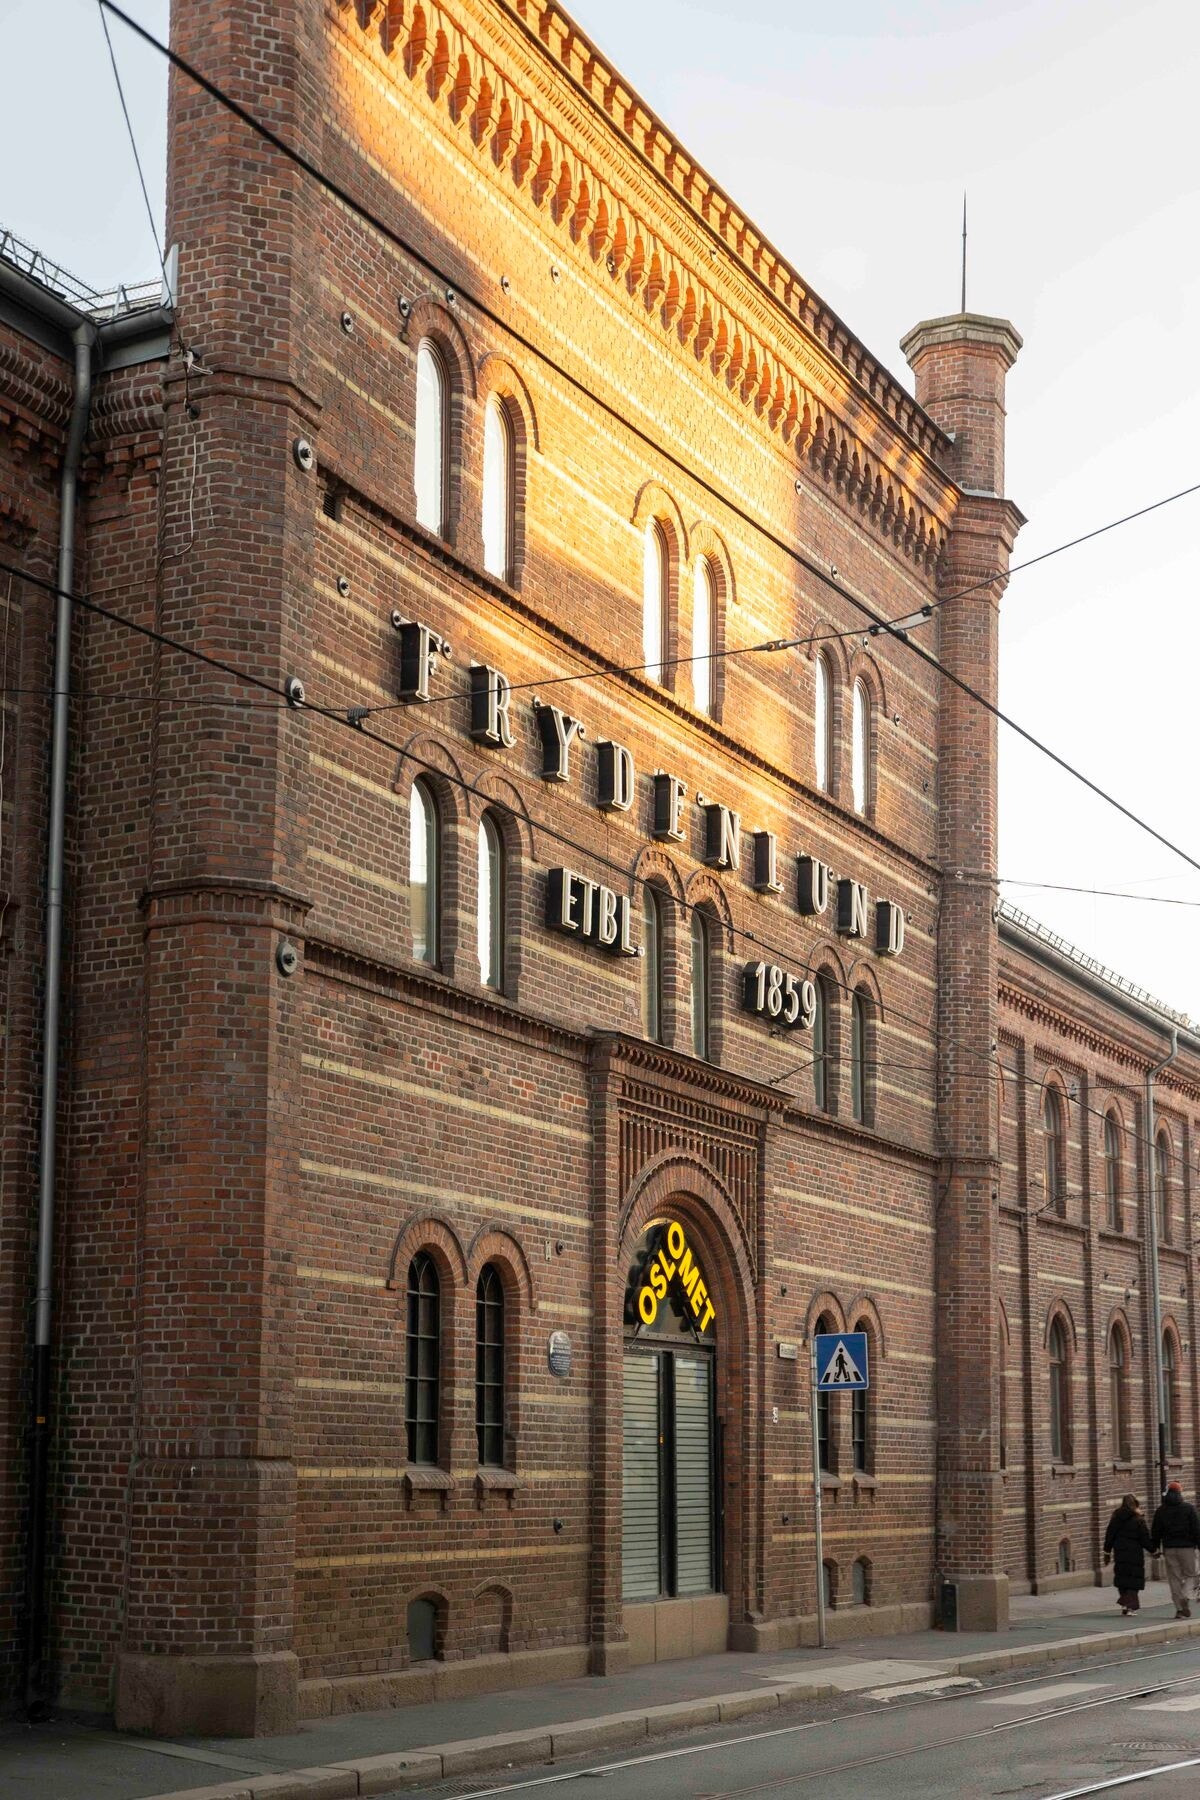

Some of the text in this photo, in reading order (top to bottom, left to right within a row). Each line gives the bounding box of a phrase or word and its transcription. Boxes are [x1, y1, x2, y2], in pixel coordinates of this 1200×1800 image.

[408, 621, 906, 957] FRYDENLUND
[751, 961, 817, 1030] 1859
[638, 1221, 716, 1333] OSLOMET
